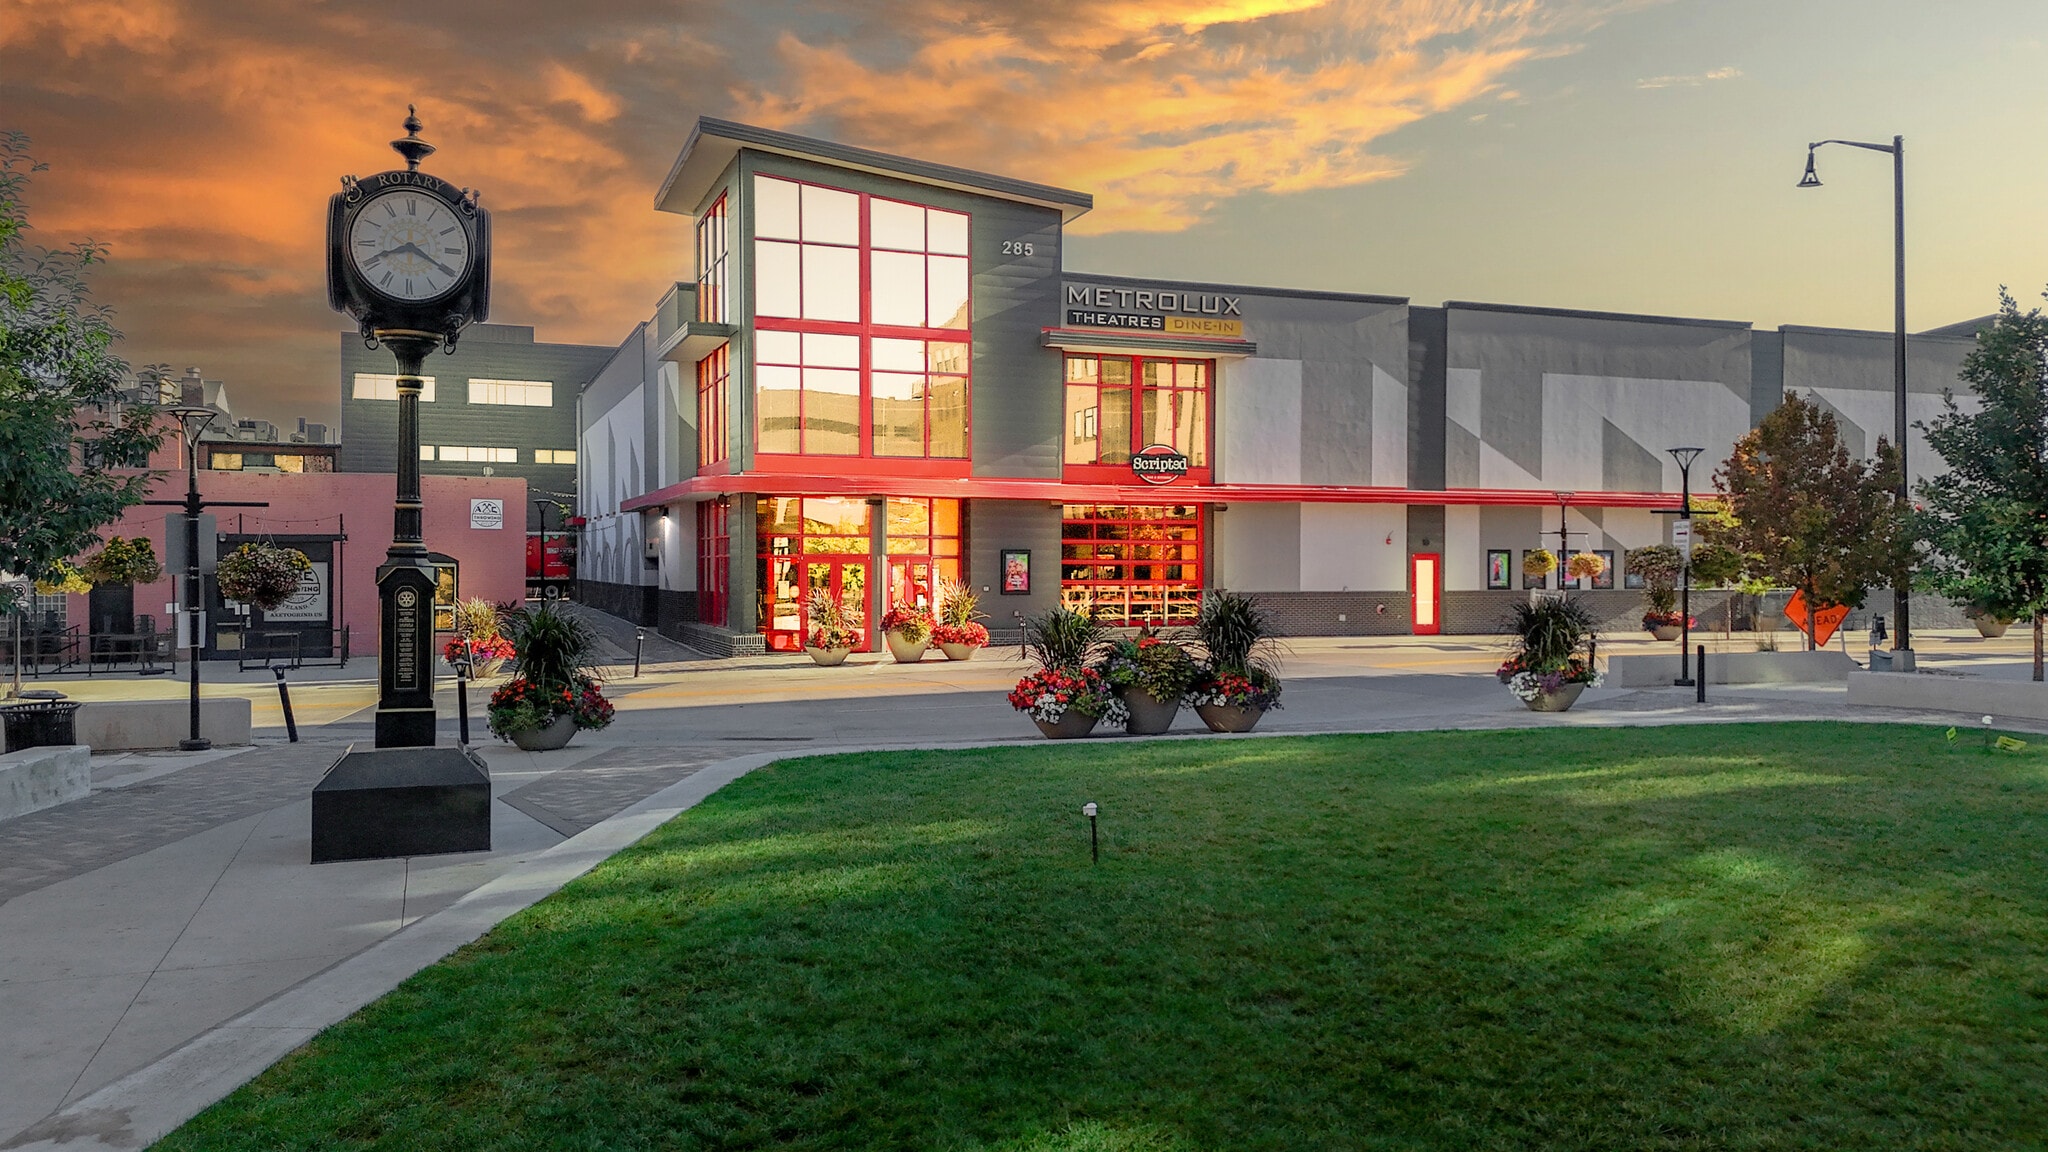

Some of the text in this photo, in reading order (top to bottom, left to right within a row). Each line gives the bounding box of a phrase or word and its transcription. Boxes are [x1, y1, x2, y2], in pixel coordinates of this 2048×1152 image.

[377, 172, 445, 191] ROTARY
[1002, 240, 1034, 257] 285
[1067, 285, 1241, 315] METROLUX
[1072, 311, 1234, 332] THEATRES DINE-IN
[1133, 457, 1188, 473] Scripted
[1802, 614, 1837, 626] AEAD
